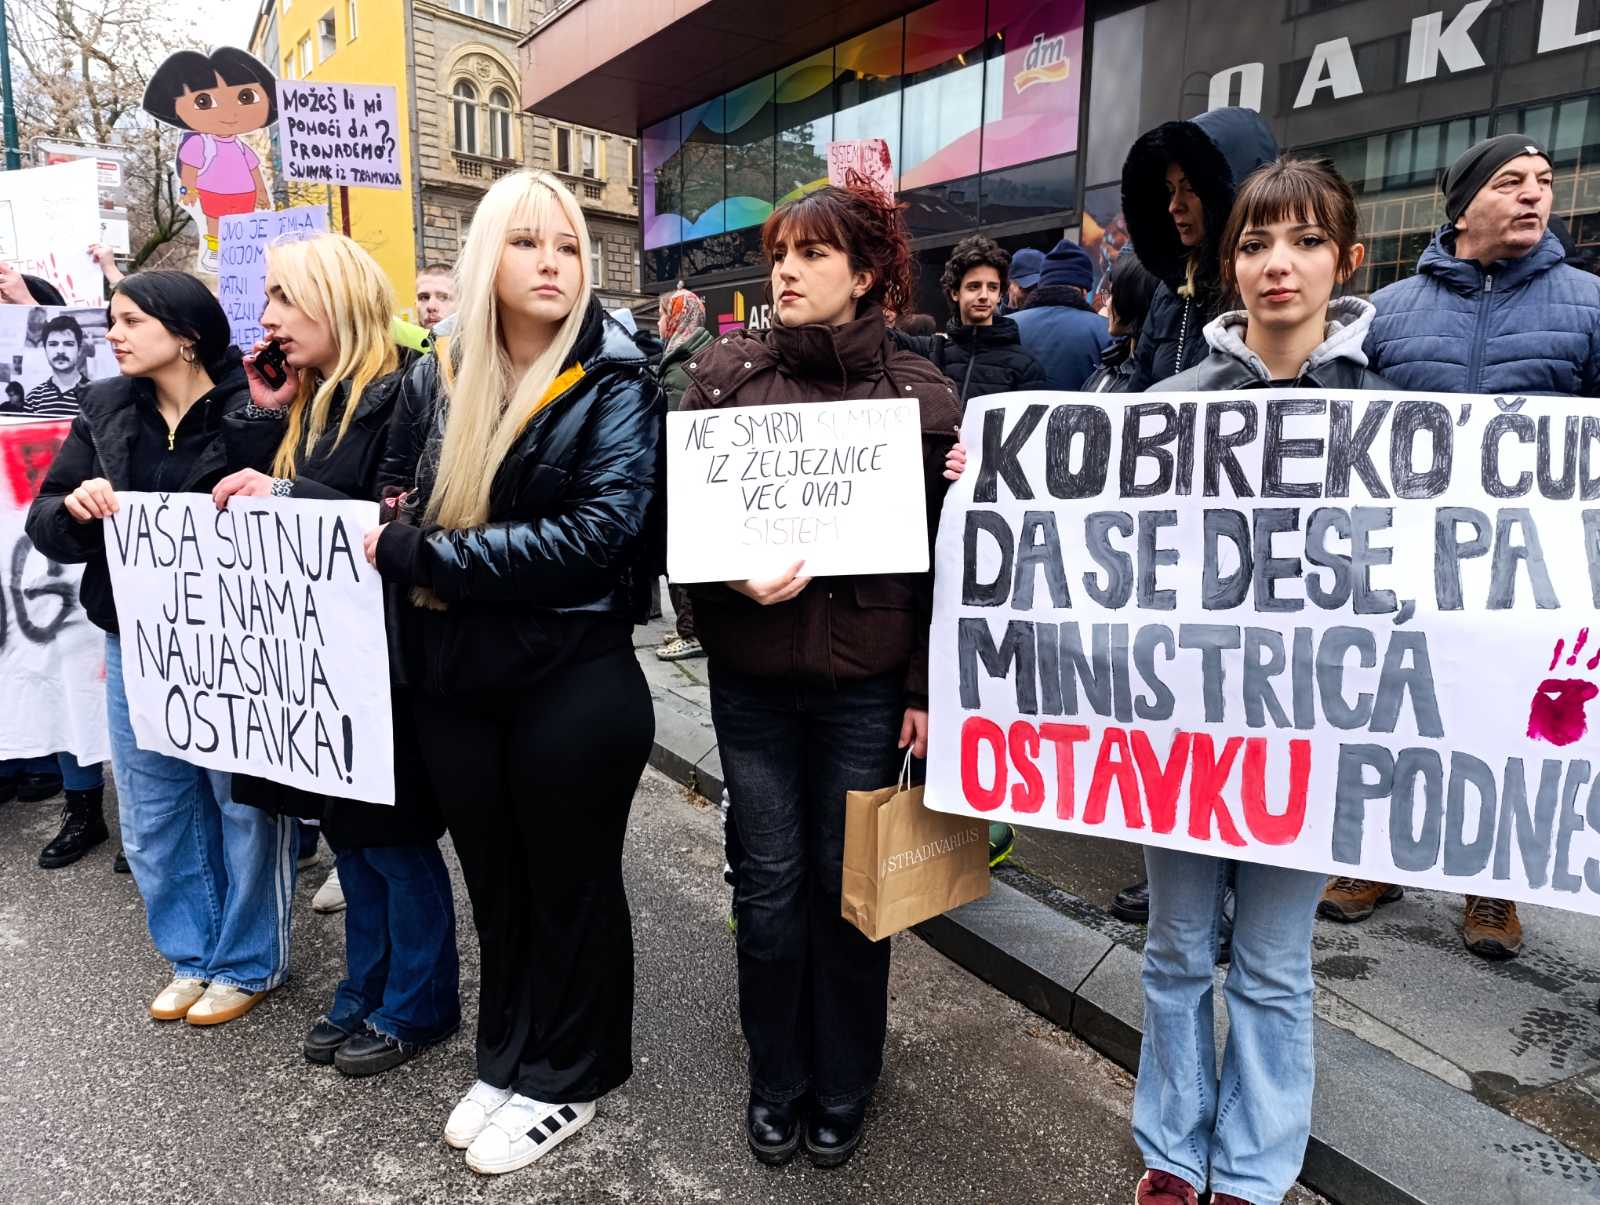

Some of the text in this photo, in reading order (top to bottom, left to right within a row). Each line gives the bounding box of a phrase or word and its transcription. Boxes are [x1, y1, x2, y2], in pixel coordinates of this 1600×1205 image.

[1025, 36, 1064, 70] dm
[685, 415, 720, 451] NE
[731, 411, 804, 448] SMRDI
[706, 454, 730, 484] IZ
[741, 478, 853, 512] VEĆ OVAJ
[110, 493, 360, 583] VAŠA SUTNJA
[741, 515, 839, 546] SISTEM
[1433, 505, 1562, 612] PA
[162, 571, 325, 647] JE NAMA
[136, 619, 340, 711] NAJJASNIJA
[164, 683, 354, 785] OSTAVKA!
[960, 715, 1312, 848] OSTAVKU
[887, 827, 981, 873] STRADIVARIUS
